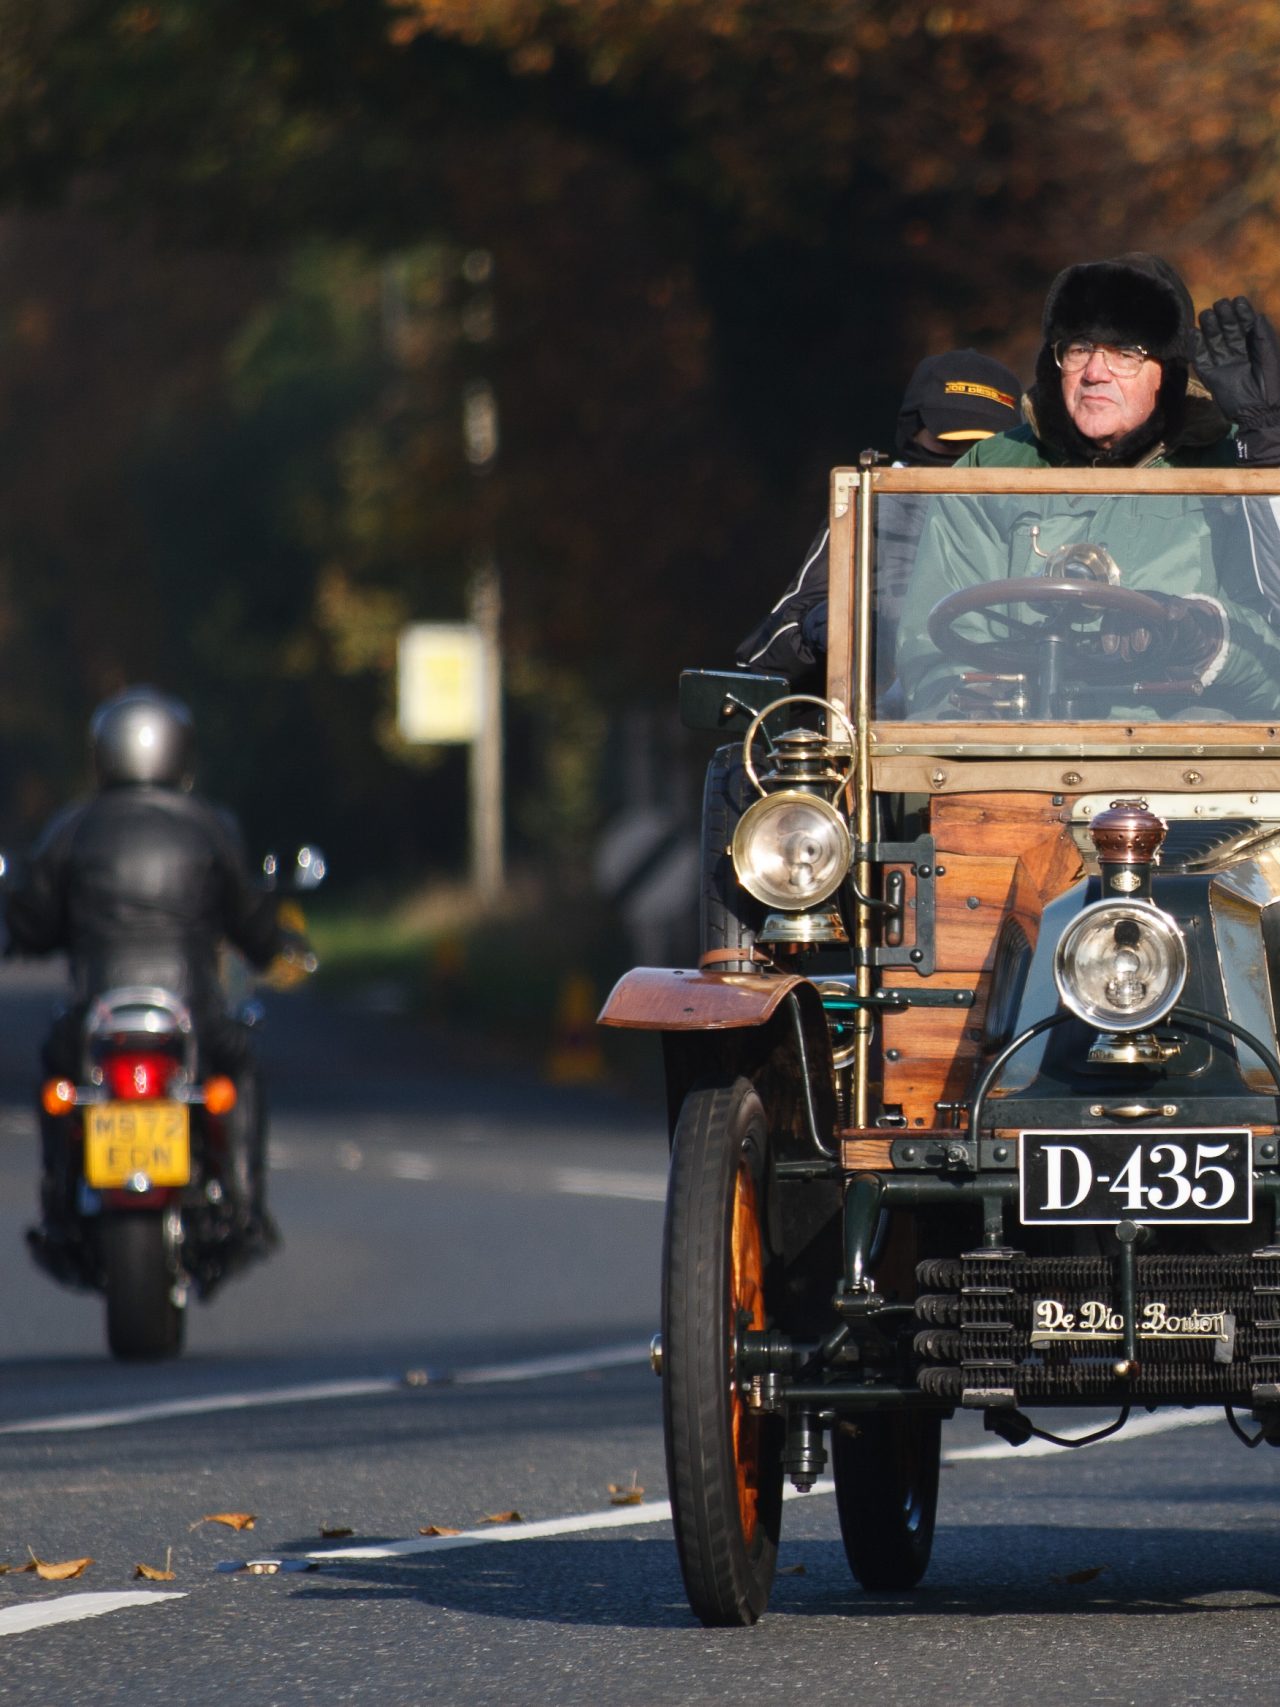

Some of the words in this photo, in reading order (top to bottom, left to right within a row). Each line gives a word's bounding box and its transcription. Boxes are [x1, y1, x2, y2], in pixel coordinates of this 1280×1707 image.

[1040, 1144, 1235, 1210] D-435
[1036, 1300, 1075, 1333] De
[1079, 1301, 1131, 1331] Dio
[1141, 1303, 1227, 1336] Bouton
